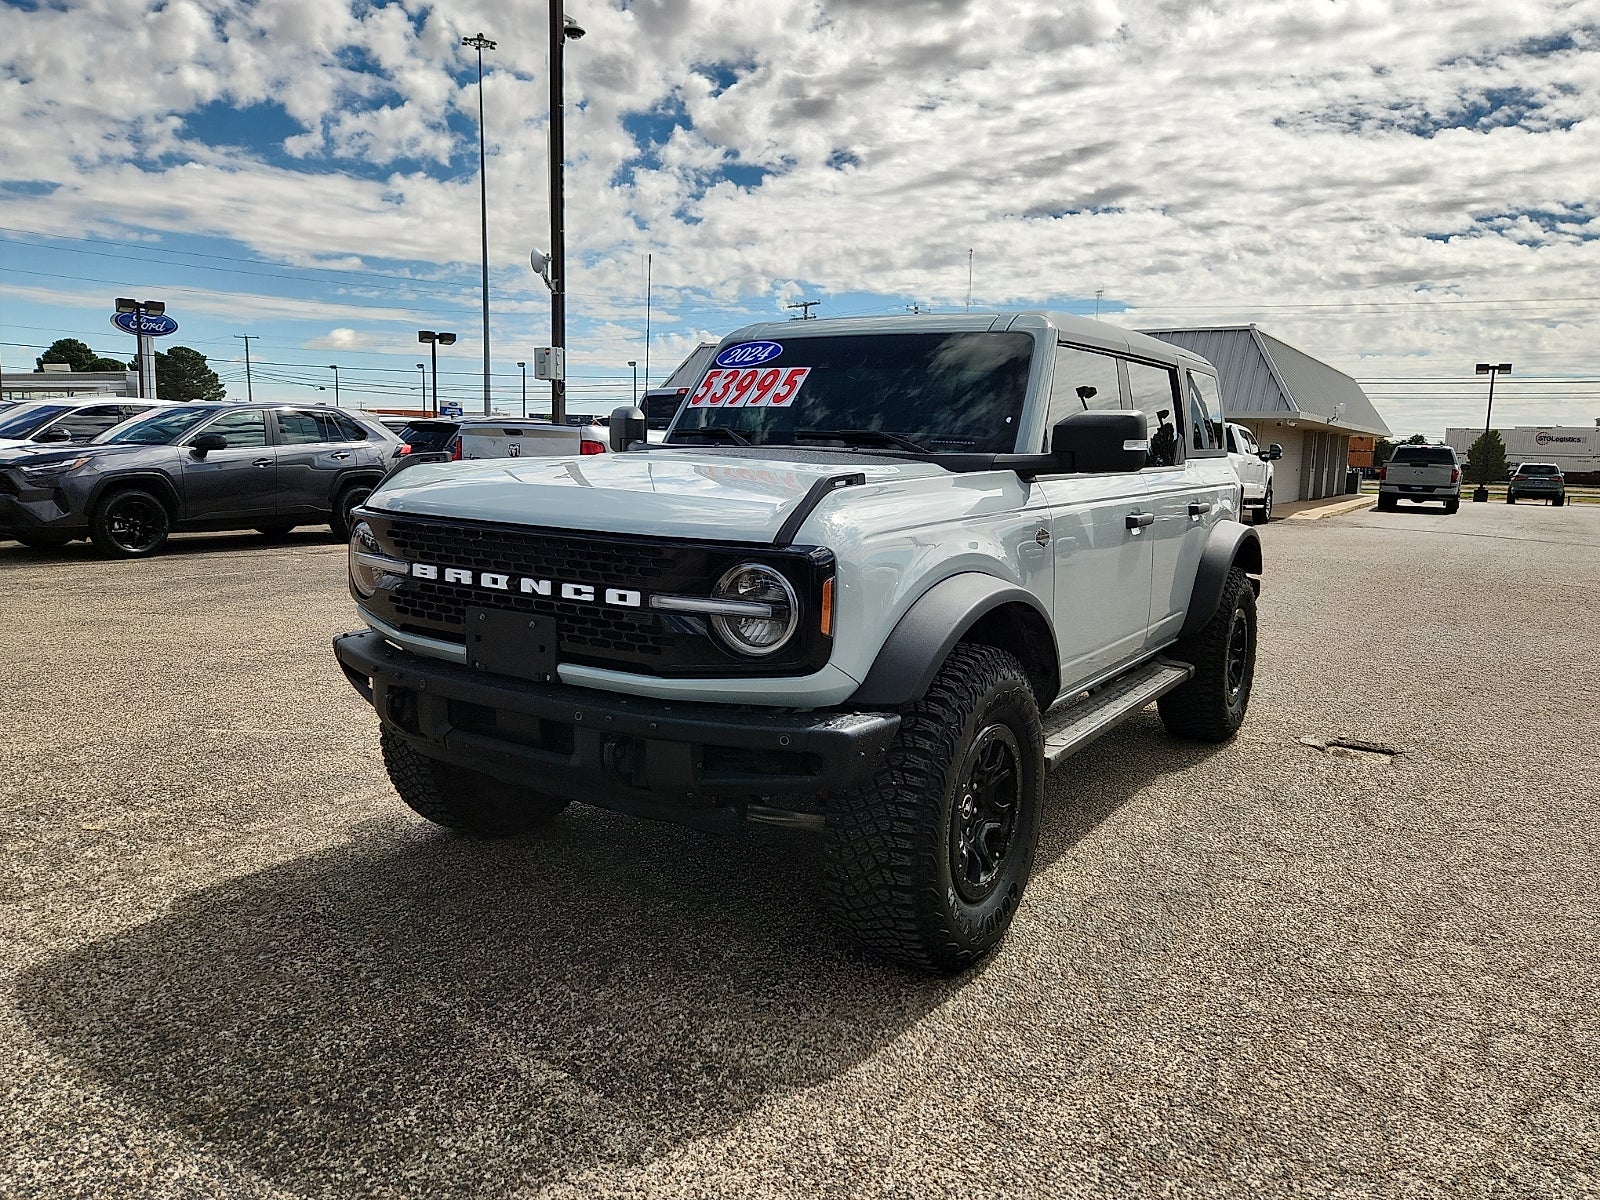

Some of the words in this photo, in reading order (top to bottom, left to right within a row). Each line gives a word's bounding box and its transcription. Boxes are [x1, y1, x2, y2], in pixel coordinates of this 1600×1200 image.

[129, 314, 166, 331] Ford
[723, 345, 776, 364] 2024
[691, 368, 807, 406] 53995
[412, 563, 641, 607] BRONCO
